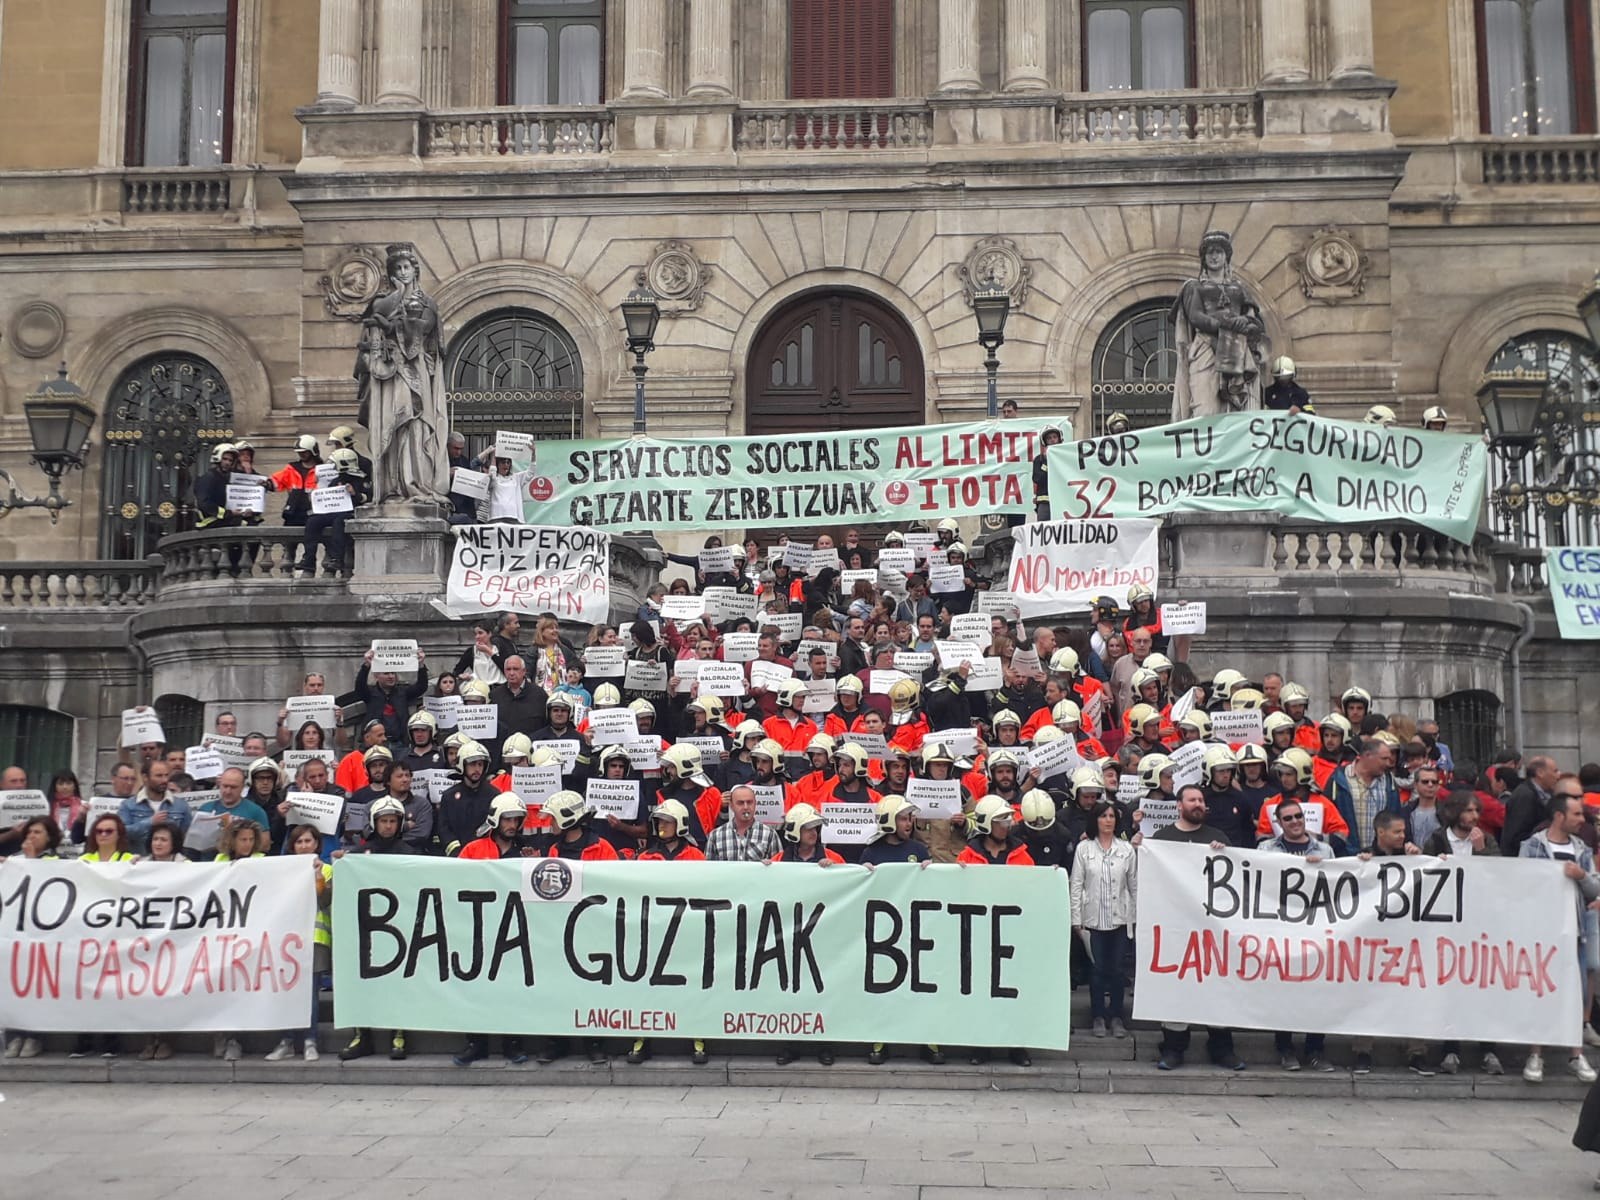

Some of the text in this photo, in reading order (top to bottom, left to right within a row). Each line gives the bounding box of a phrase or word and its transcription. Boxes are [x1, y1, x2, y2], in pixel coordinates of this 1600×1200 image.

[567, 432, 1039, 485] SERVICIOS SOCIALES AL LIMIT
[1078, 418, 1423, 470] POR TU SEGURIDAD
[569, 474, 1023, 527] GIZARTE ZERBITZUAK ITOTA
[1063, 467, 1427, 519] 32 BOMBEROS A DIARIO
[459, 526, 607, 557] MENPEKOAK
[1030, 520, 1118, 547] MOVILIDAD
[464, 569, 606, 596] BALORAZIOA
[1011, 554, 1154, 593] NO MOVILIDAD
[589, 793, 635, 801] BALORAZIOA
[590, 783, 635, 791] ATEZAINTZA
[1143, 803, 1177, 811] ATEZAIN
[824, 806, 873, 814] ATEZAINTZA
[0, 875, 258, 932] 10 GREBAN
[1202, 855, 1465, 925] BILBAO BIZI
[10, 931, 304, 1000] UN PASO ATRAS
[358, 887, 1022, 999] BAJA GUZTIAK BETE
[1150, 925, 1558, 998] LAN BALDINTZA DUINAK
[575, 1009, 825, 1035] LANGILEEN BATZORDEA
